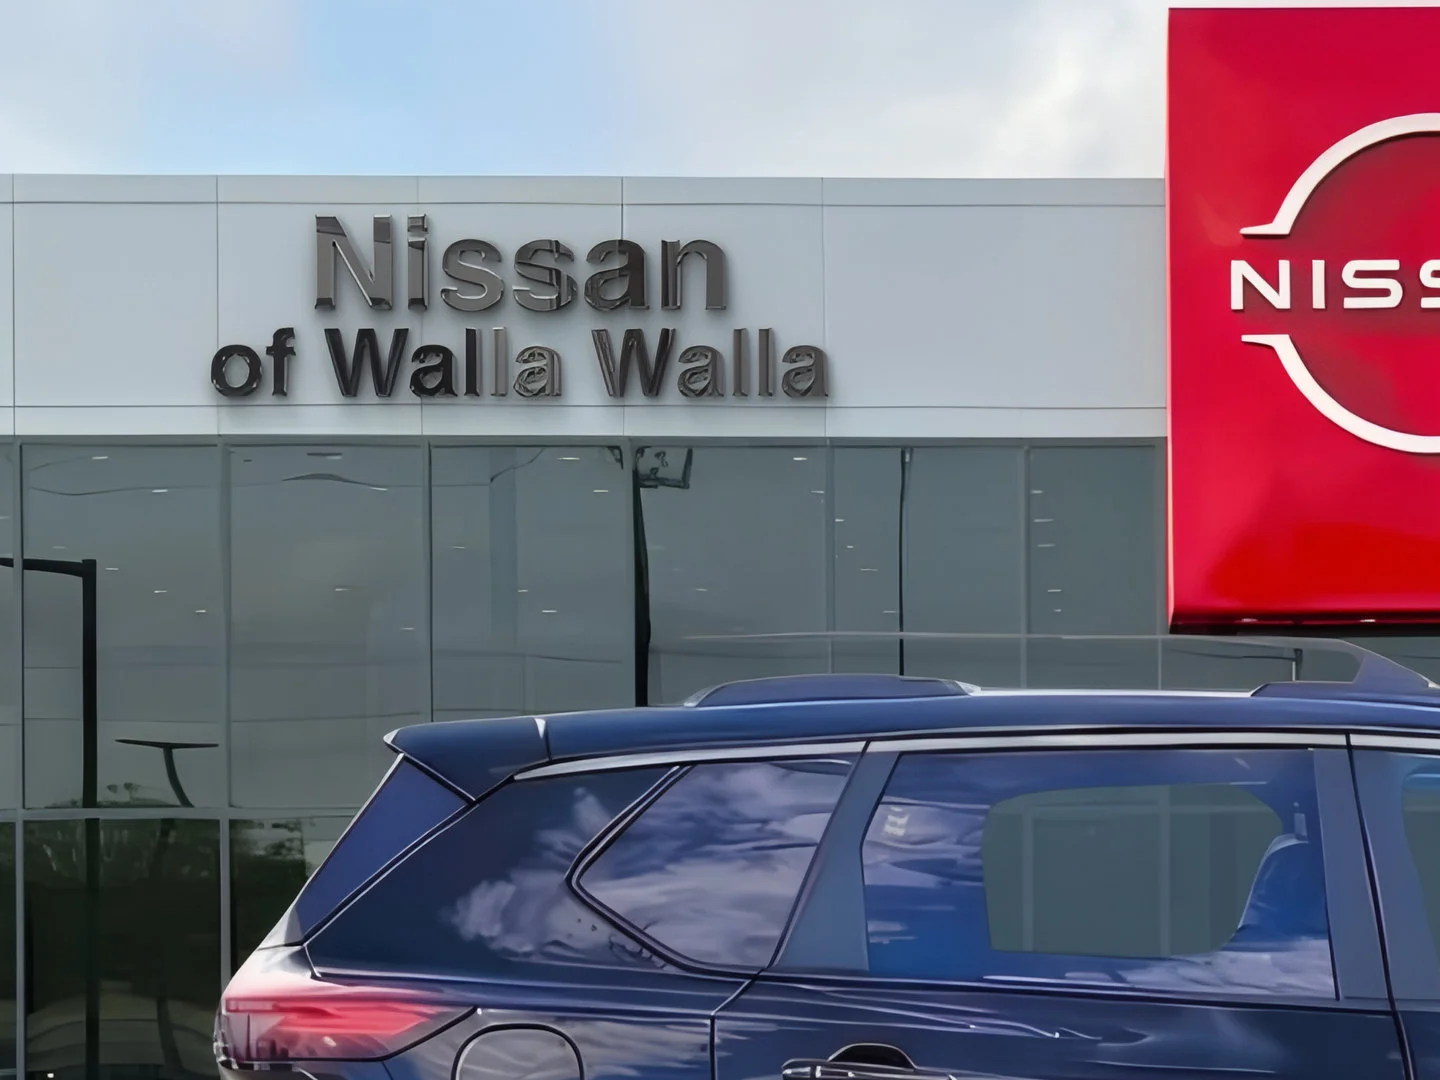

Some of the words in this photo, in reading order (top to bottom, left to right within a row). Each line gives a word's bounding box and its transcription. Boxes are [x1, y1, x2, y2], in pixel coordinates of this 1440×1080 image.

[314, 213, 728, 312] Nissan
[210, 326, 296, 398] of
[323, 327, 563, 398] Walla
[590, 327, 830, 399] Walla
